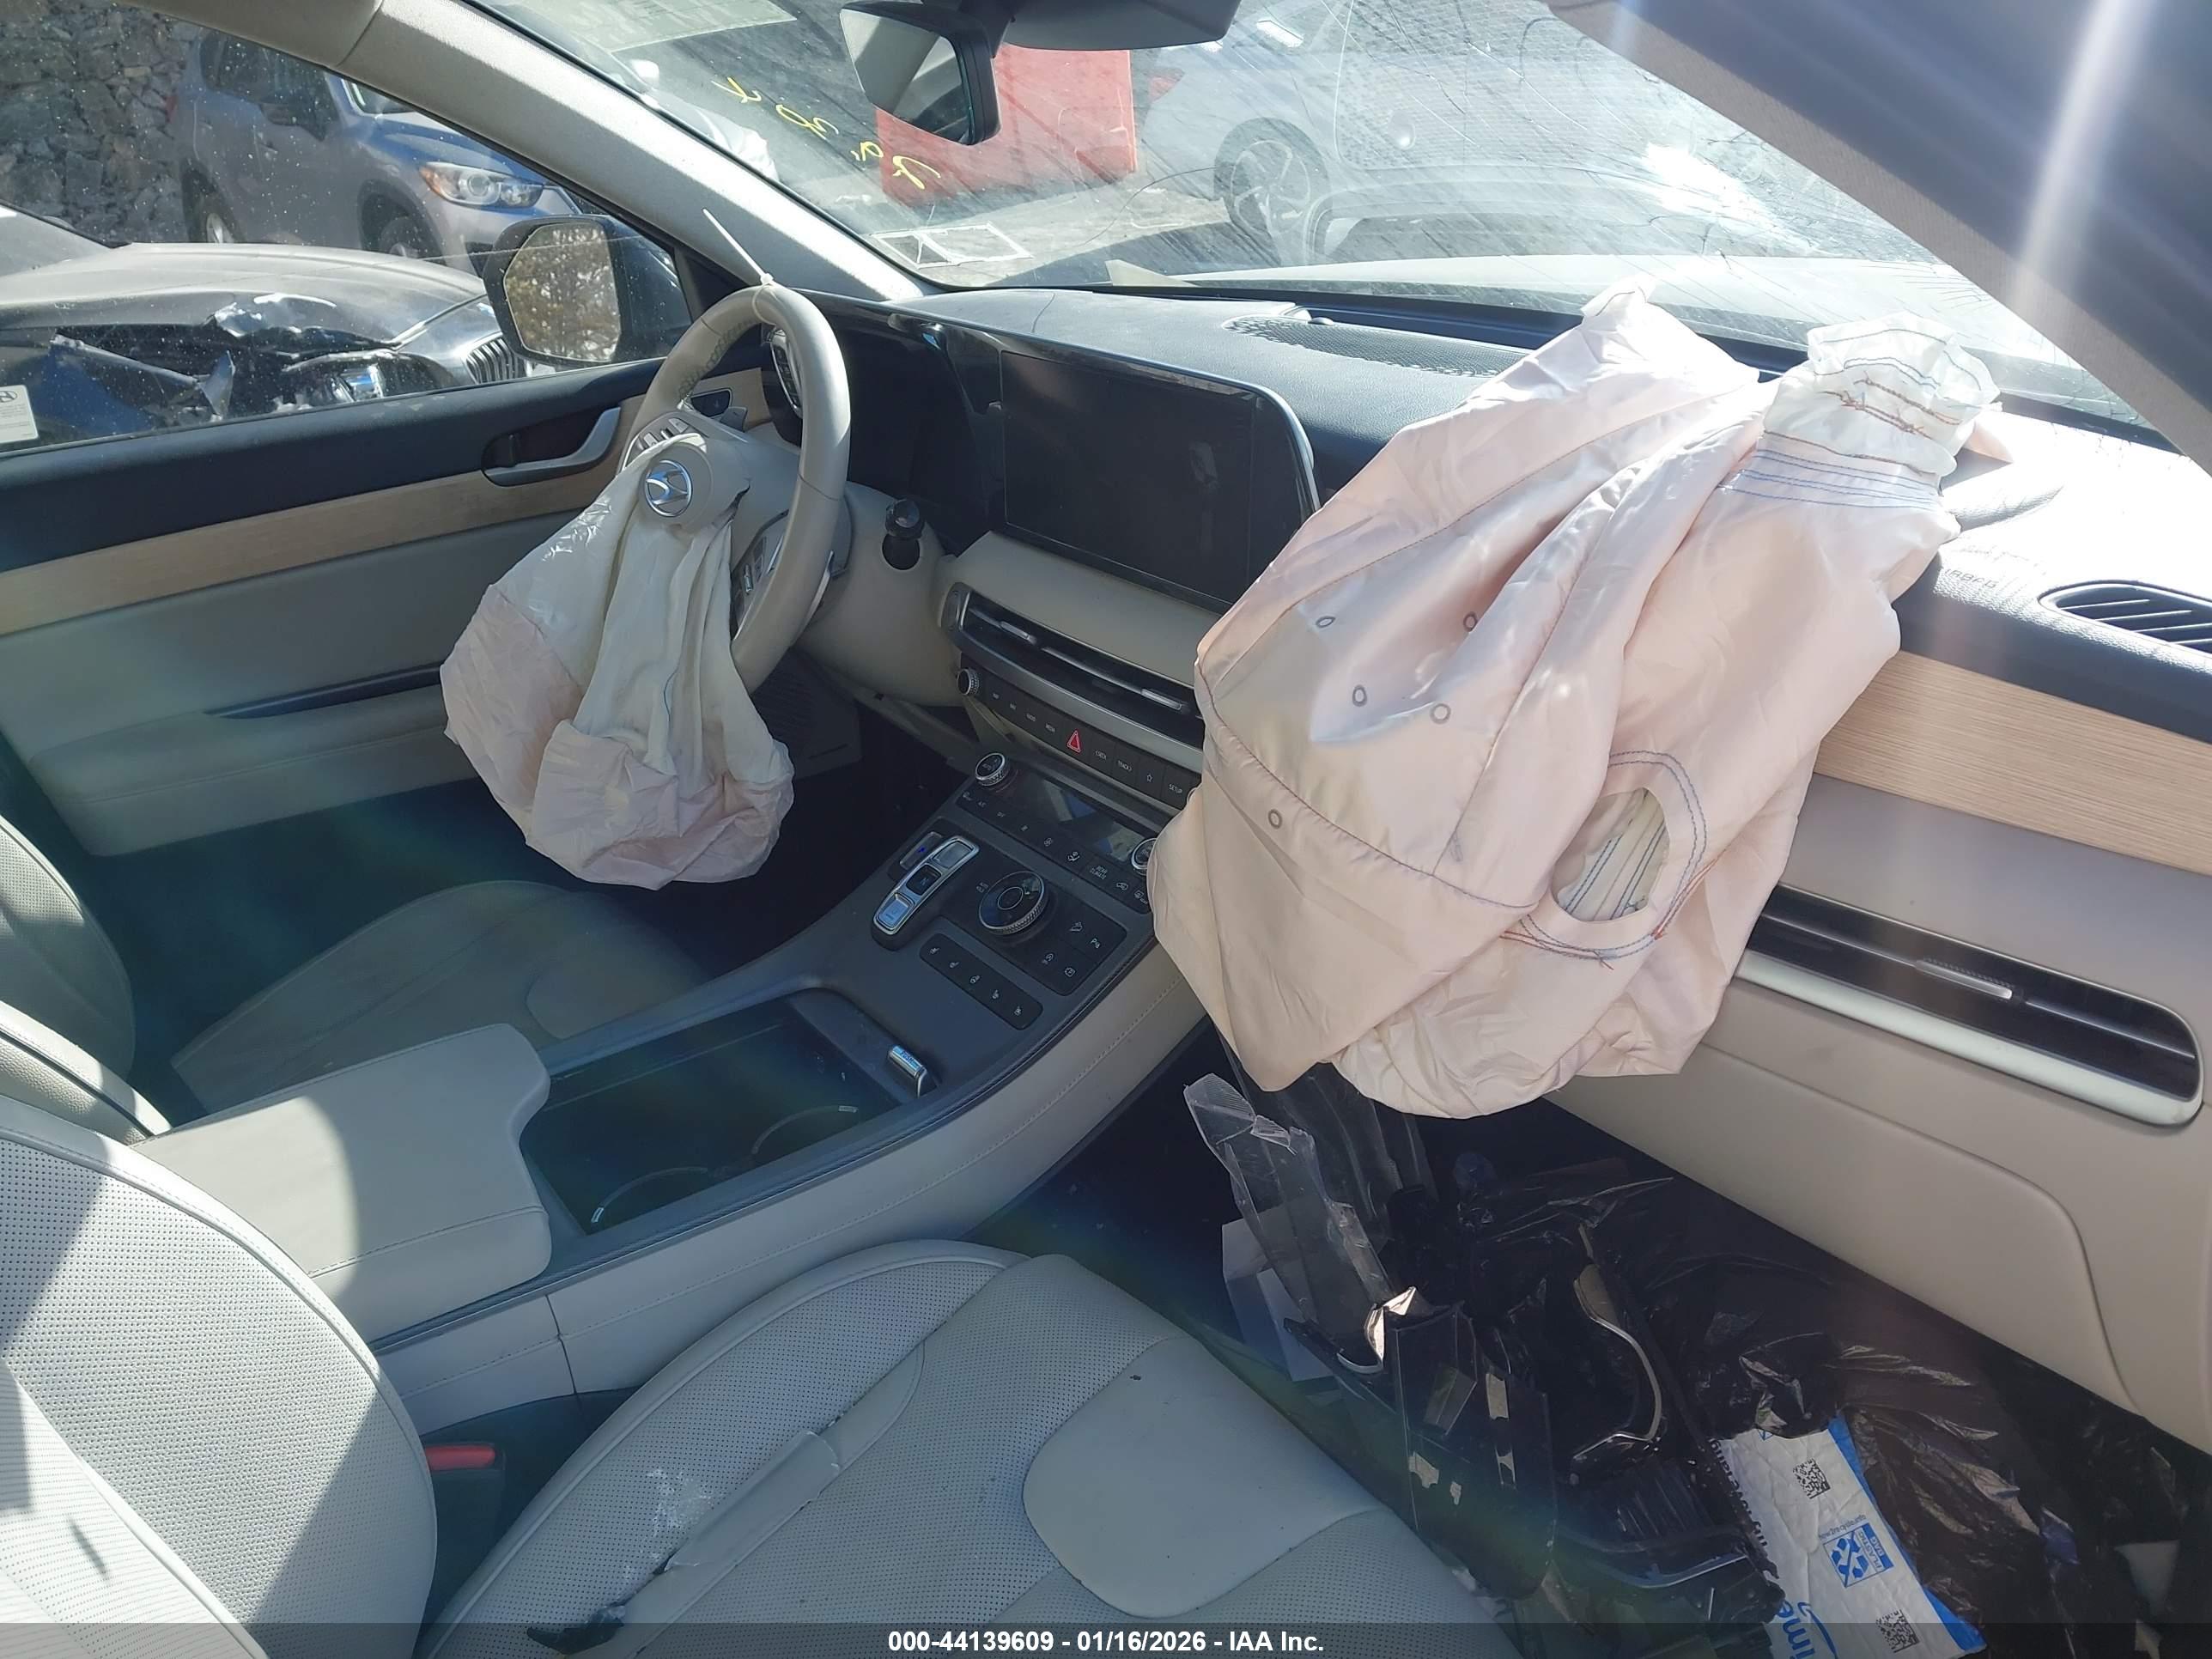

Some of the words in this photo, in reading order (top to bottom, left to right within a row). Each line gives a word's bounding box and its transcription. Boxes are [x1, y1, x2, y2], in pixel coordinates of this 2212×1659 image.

[1944, 568, 1996, 589] IRBAG
[1169, 783, 1182, 794] SETUP
[1858, 1530, 1882, 1569] PLASTIC
[1869, 1535, 1887, 1556] BAG
